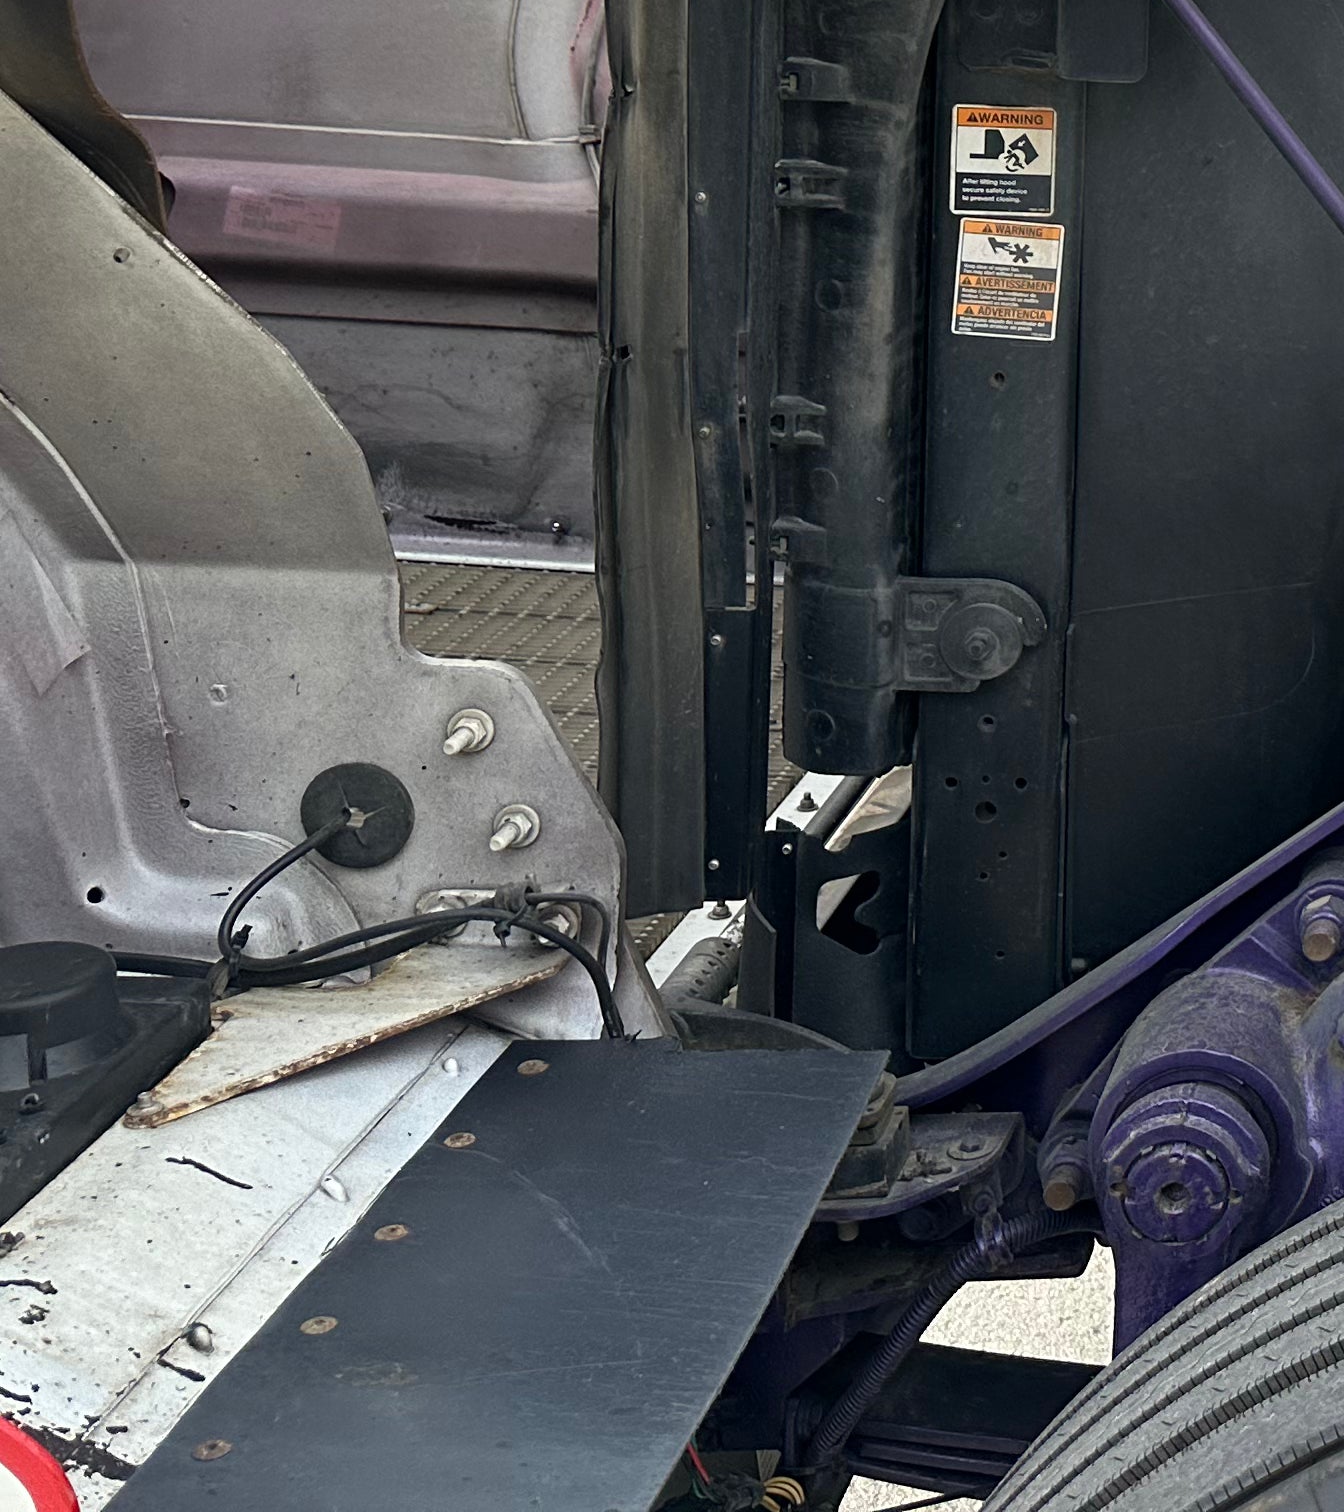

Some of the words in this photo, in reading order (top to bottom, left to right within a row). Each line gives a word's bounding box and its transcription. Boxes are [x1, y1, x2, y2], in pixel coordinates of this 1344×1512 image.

[979, 113, 1044, 125] WARNING
[995, 225, 1043, 237] WARNING
[975, 277, 1054, 291] AVERTISSEMENT
[978, 306, 1046, 320] ADVERTENCIA
